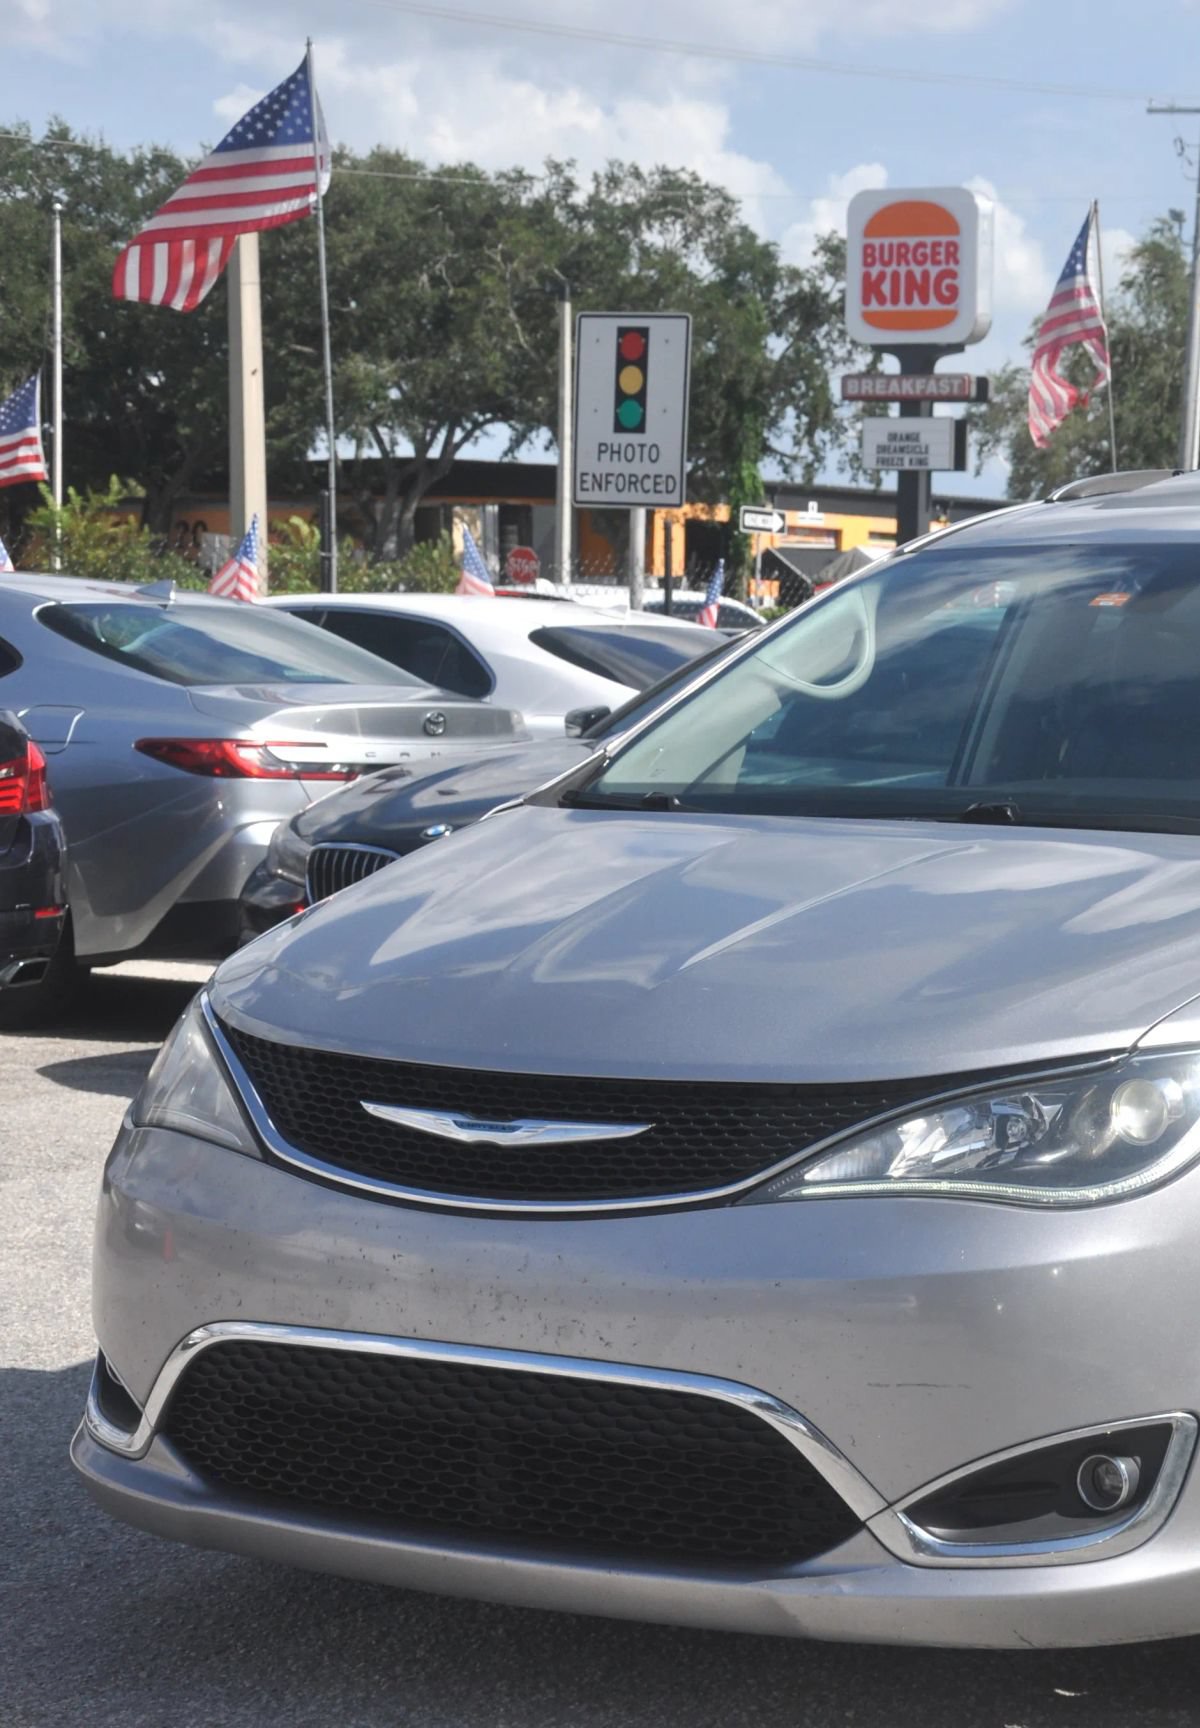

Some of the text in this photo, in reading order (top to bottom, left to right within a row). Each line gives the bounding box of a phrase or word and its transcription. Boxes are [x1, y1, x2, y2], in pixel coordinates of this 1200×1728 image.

[862, 241, 960, 268] BURGER
[861, 268, 960, 307] KING
[847, 376, 963, 396] BREAKFAST
[597, 442, 661, 464] PHOTO
[579, 472, 677, 495] ENFORCED
